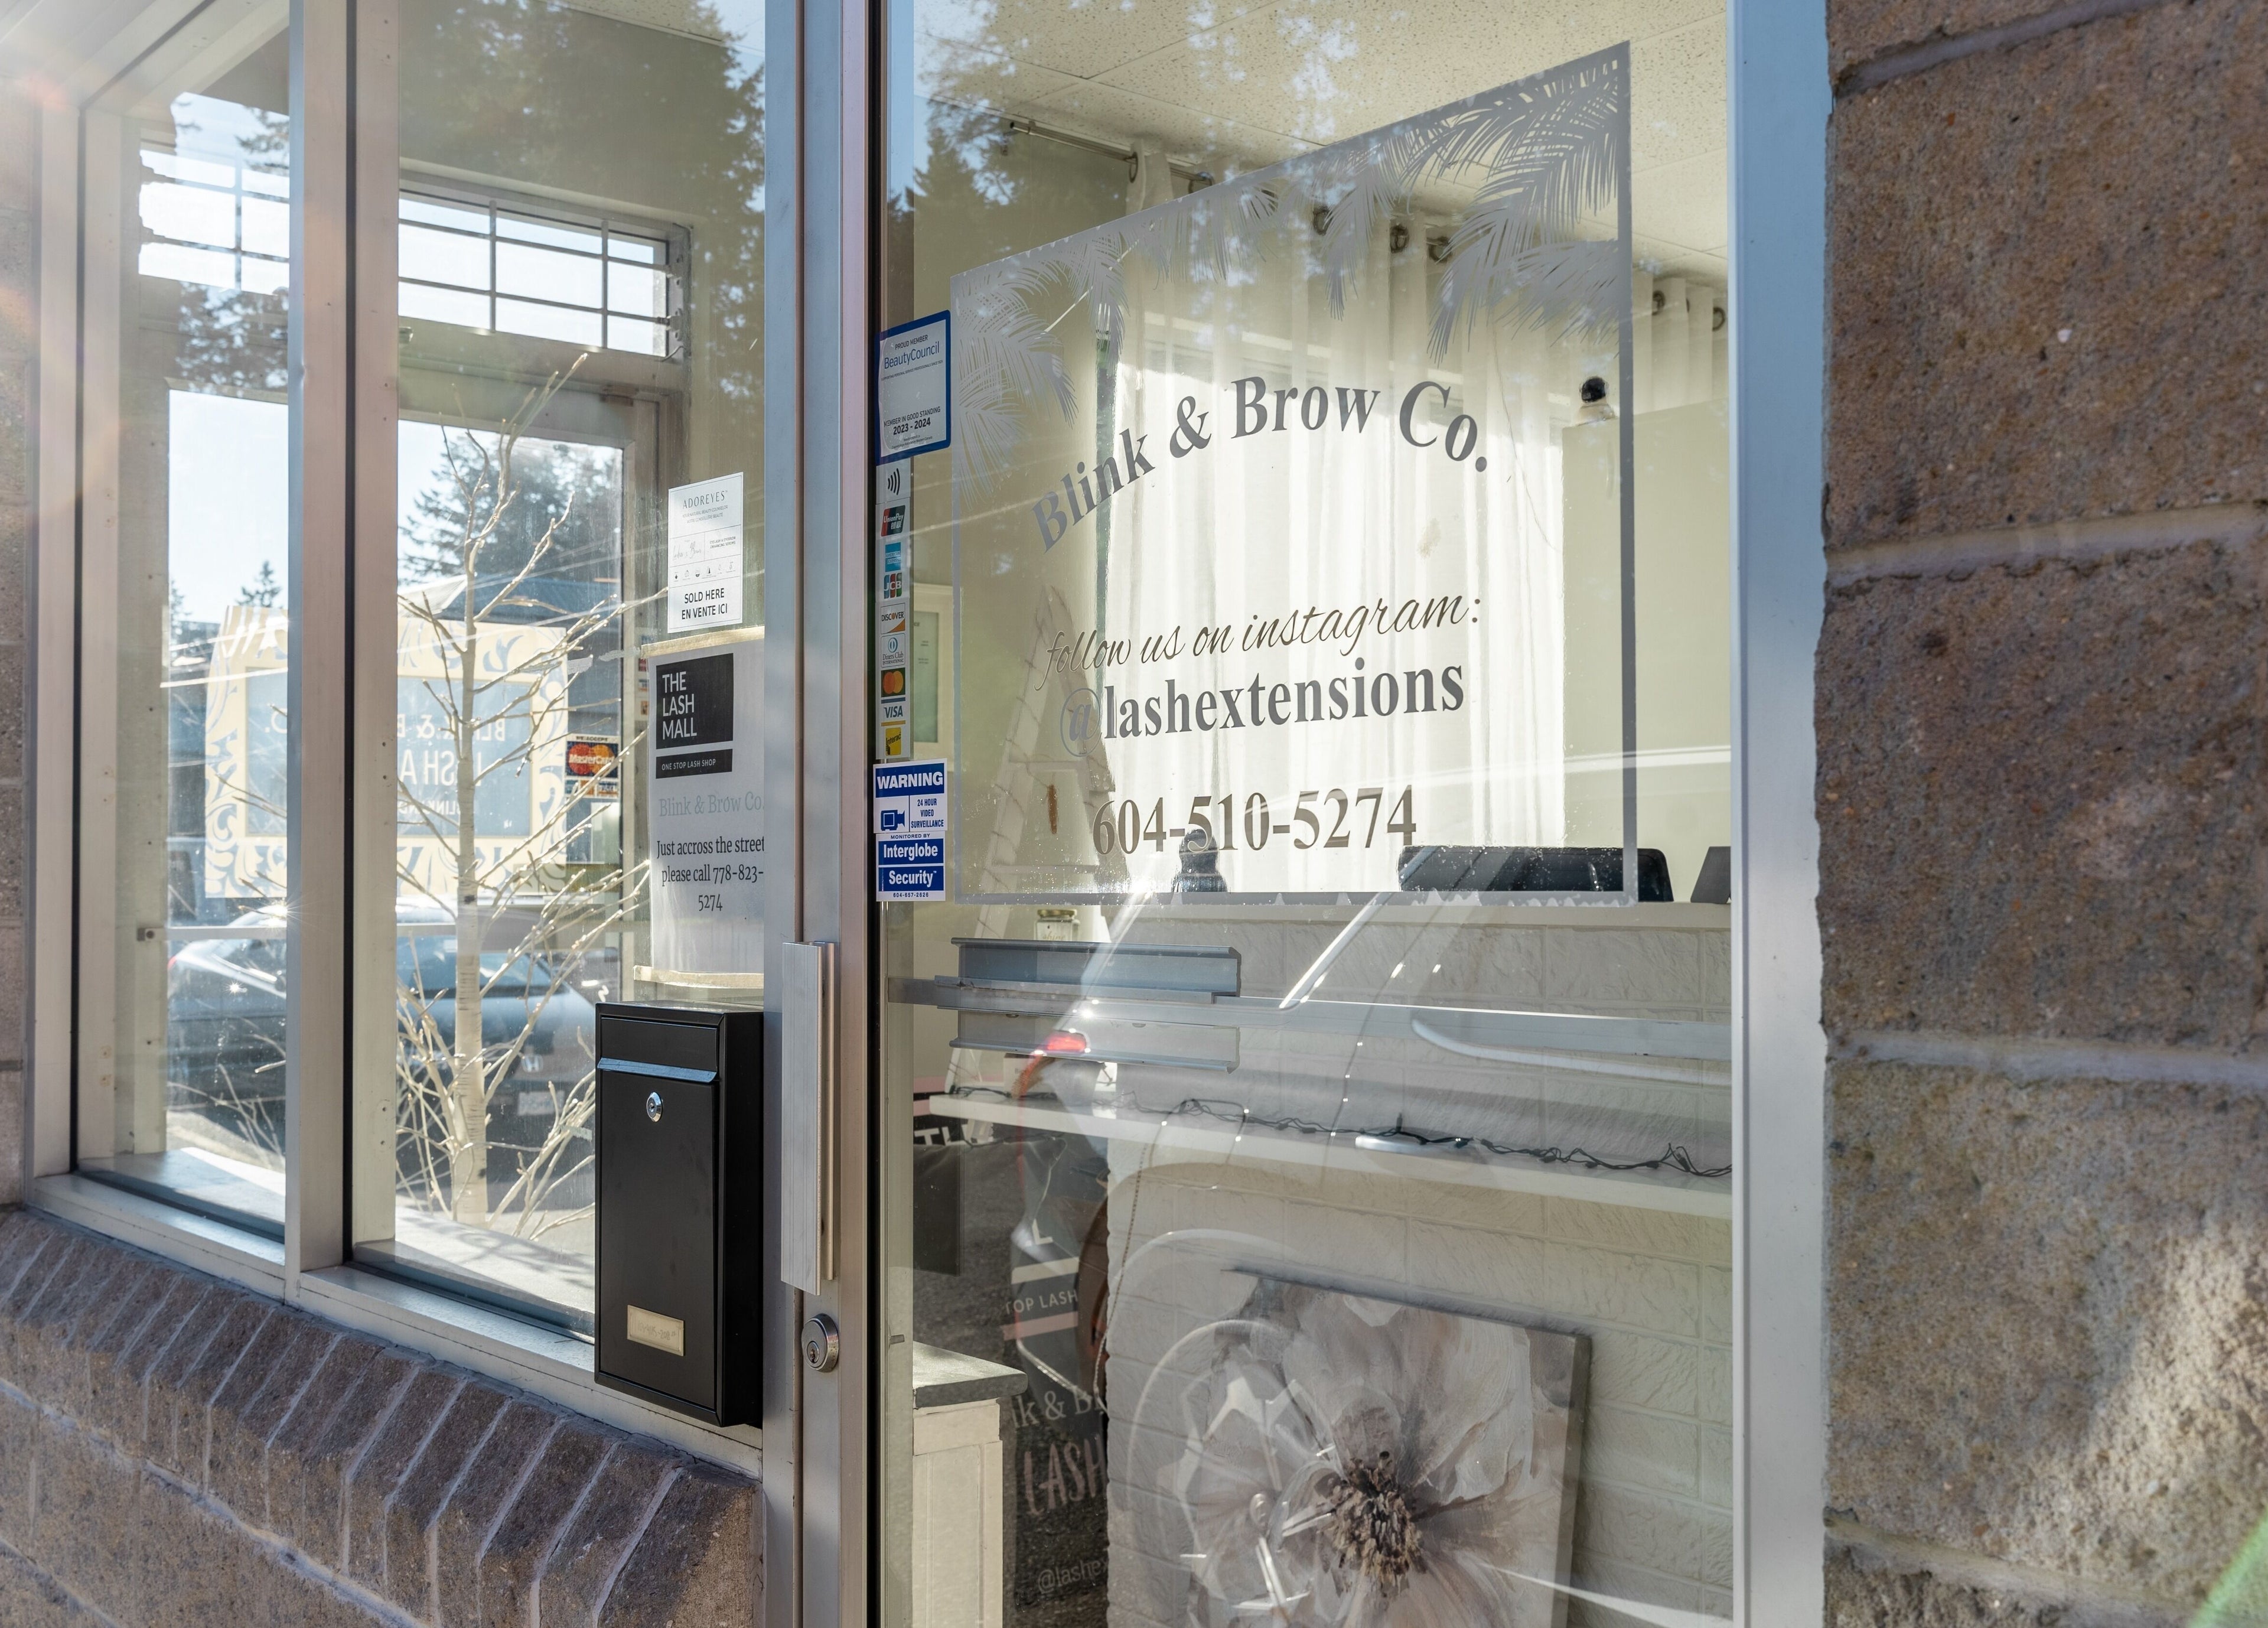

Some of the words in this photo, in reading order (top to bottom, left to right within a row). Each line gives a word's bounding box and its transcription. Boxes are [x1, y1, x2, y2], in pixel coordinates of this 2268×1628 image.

[895, 340, 910, 350] PROUD
[910, 335, 928, 346] MEMBER
[884, 341, 939, 370] BeautyCouncil
[884, 417, 901, 427] MEMBER
[907, 412, 919, 421] GOOD
[920, 406, 940, 418] STANDING
[893, 423, 909, 435] 2023
[914, 417, 931, 429] 2024
[1031, 427, 1155, 553] Blink
[1169, 396, 1211, 458] &
[1230, 376, 1381, 438] Brow
[1399, 381, 1487, 473] Co.
[884, 513, 904, 523] UnionPay
[684, 591, 703, 604] SOLD
[705, 588, 724, 600] HERE
[885, 581, 901, 591] JCB
[682, 610, 691, 620] EN
[693, 605, 716, 618] VENTE
[718, 603, 728, 614] ICI
[882, 611, 904, 621] DISCOVER
[1034, 629, 1131, 691] follow
[1141, 630, 1185, 663] us
[1193, 623, 1234, 657] on
[1242, 595, 1481, 656] instagram:
[662, 671, 686, 693] THE
[663, 693, 694, 717] LASH
[884, 705, 903, 718] VISA
[1060, 657, 1464, 758] @lashextensions
[663, 717, 697, 740] MALL
[876, 771, 943, 789] WARNING
[659, 796, 691, 817] Blink
[695, 795, 705, 814] &
[708, 795, 741, 813] Brow
[911, 819, 944, 828] SURVEILLANCE
[1092, 784, 1417, 855] 604-510-5274
[657, 841, 674, 859] Just
[677, 842, 713, 855] accross
[715, 836, 732, 854] the
[883, 842, 938, 861] Interglobe
[662, 865, 690, 887] please
[693, 864, 711, 882] call
[713, 864, 764, 884] 778-823-
[698, 894, 722, 911] 5274
[1039, 1290, 1078, 1308] LASH
[1044, 1391, 1066, 1420] &
[1025, 1434, 1108, 1516] LASH
